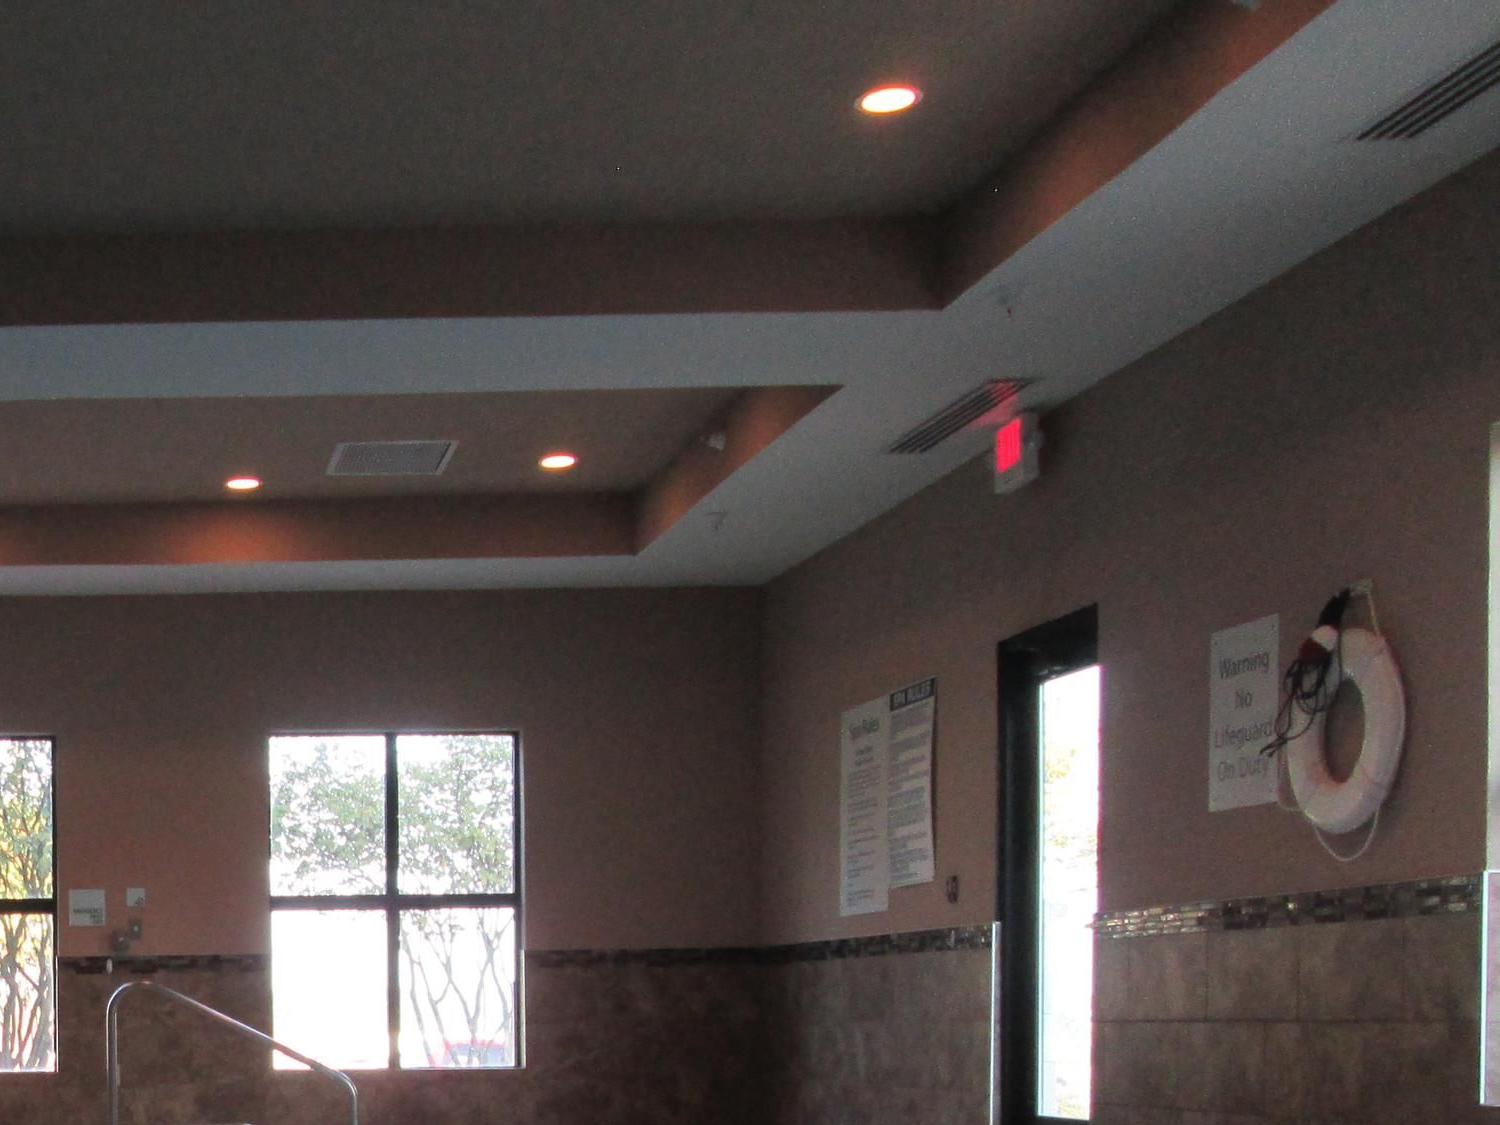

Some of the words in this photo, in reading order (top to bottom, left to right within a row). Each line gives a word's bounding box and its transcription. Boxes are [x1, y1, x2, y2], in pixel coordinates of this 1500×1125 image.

[1219, 652, 1270, 680] Warning
[1235, 690, 1253, 709] No
[1214, 719, 1273, 748] Lifeguard
[1218, 761, 1235, 782] On
[1239, 756, 1270, 779] Duty
